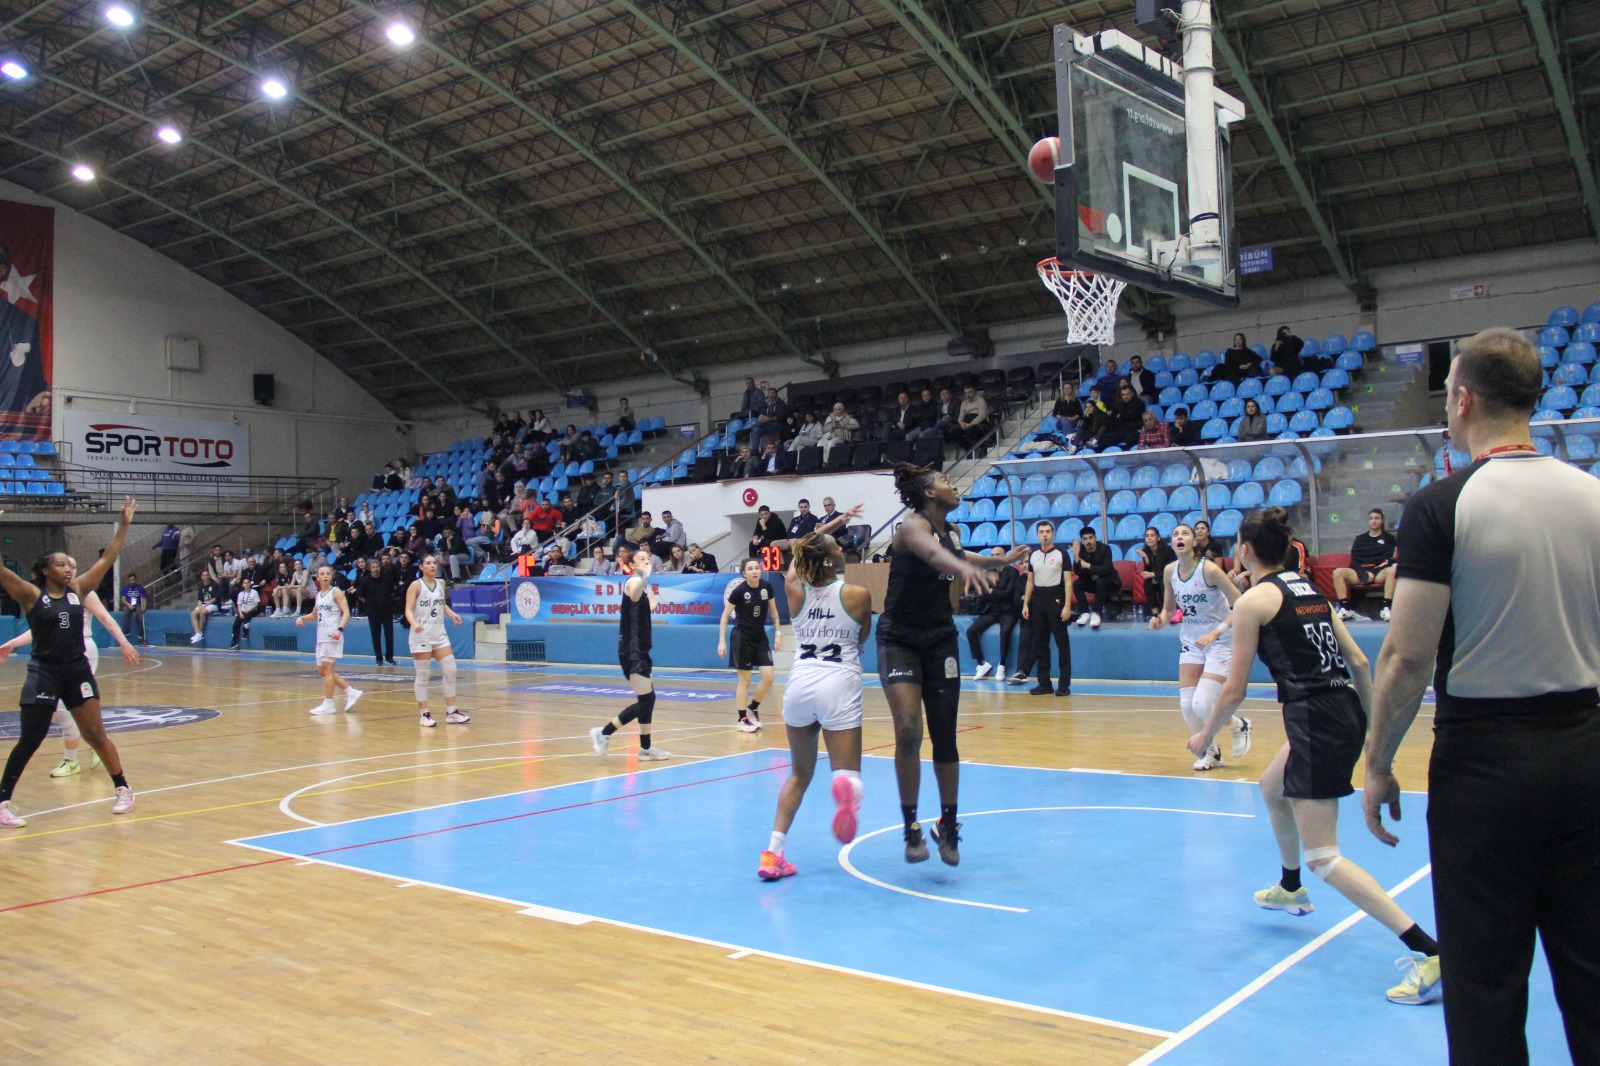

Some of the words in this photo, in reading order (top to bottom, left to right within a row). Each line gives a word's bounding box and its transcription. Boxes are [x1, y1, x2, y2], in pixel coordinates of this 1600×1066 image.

[1240, 250, 1268, 261] RİBÜN
[762, 546, 781, 571] 33
[595, 582, 660, 596] EDİE
[1182, 593, 1208, 604] SPOR
[431, 608, 437, 617] 6
[551, 602, 591, 616] GENÇLİK
[593, 603, 605, 615] VE
[607, 603, 621, 615] SPO
[808, 607, 835, 620] HILL
[58, 611, 70, 629] 3
